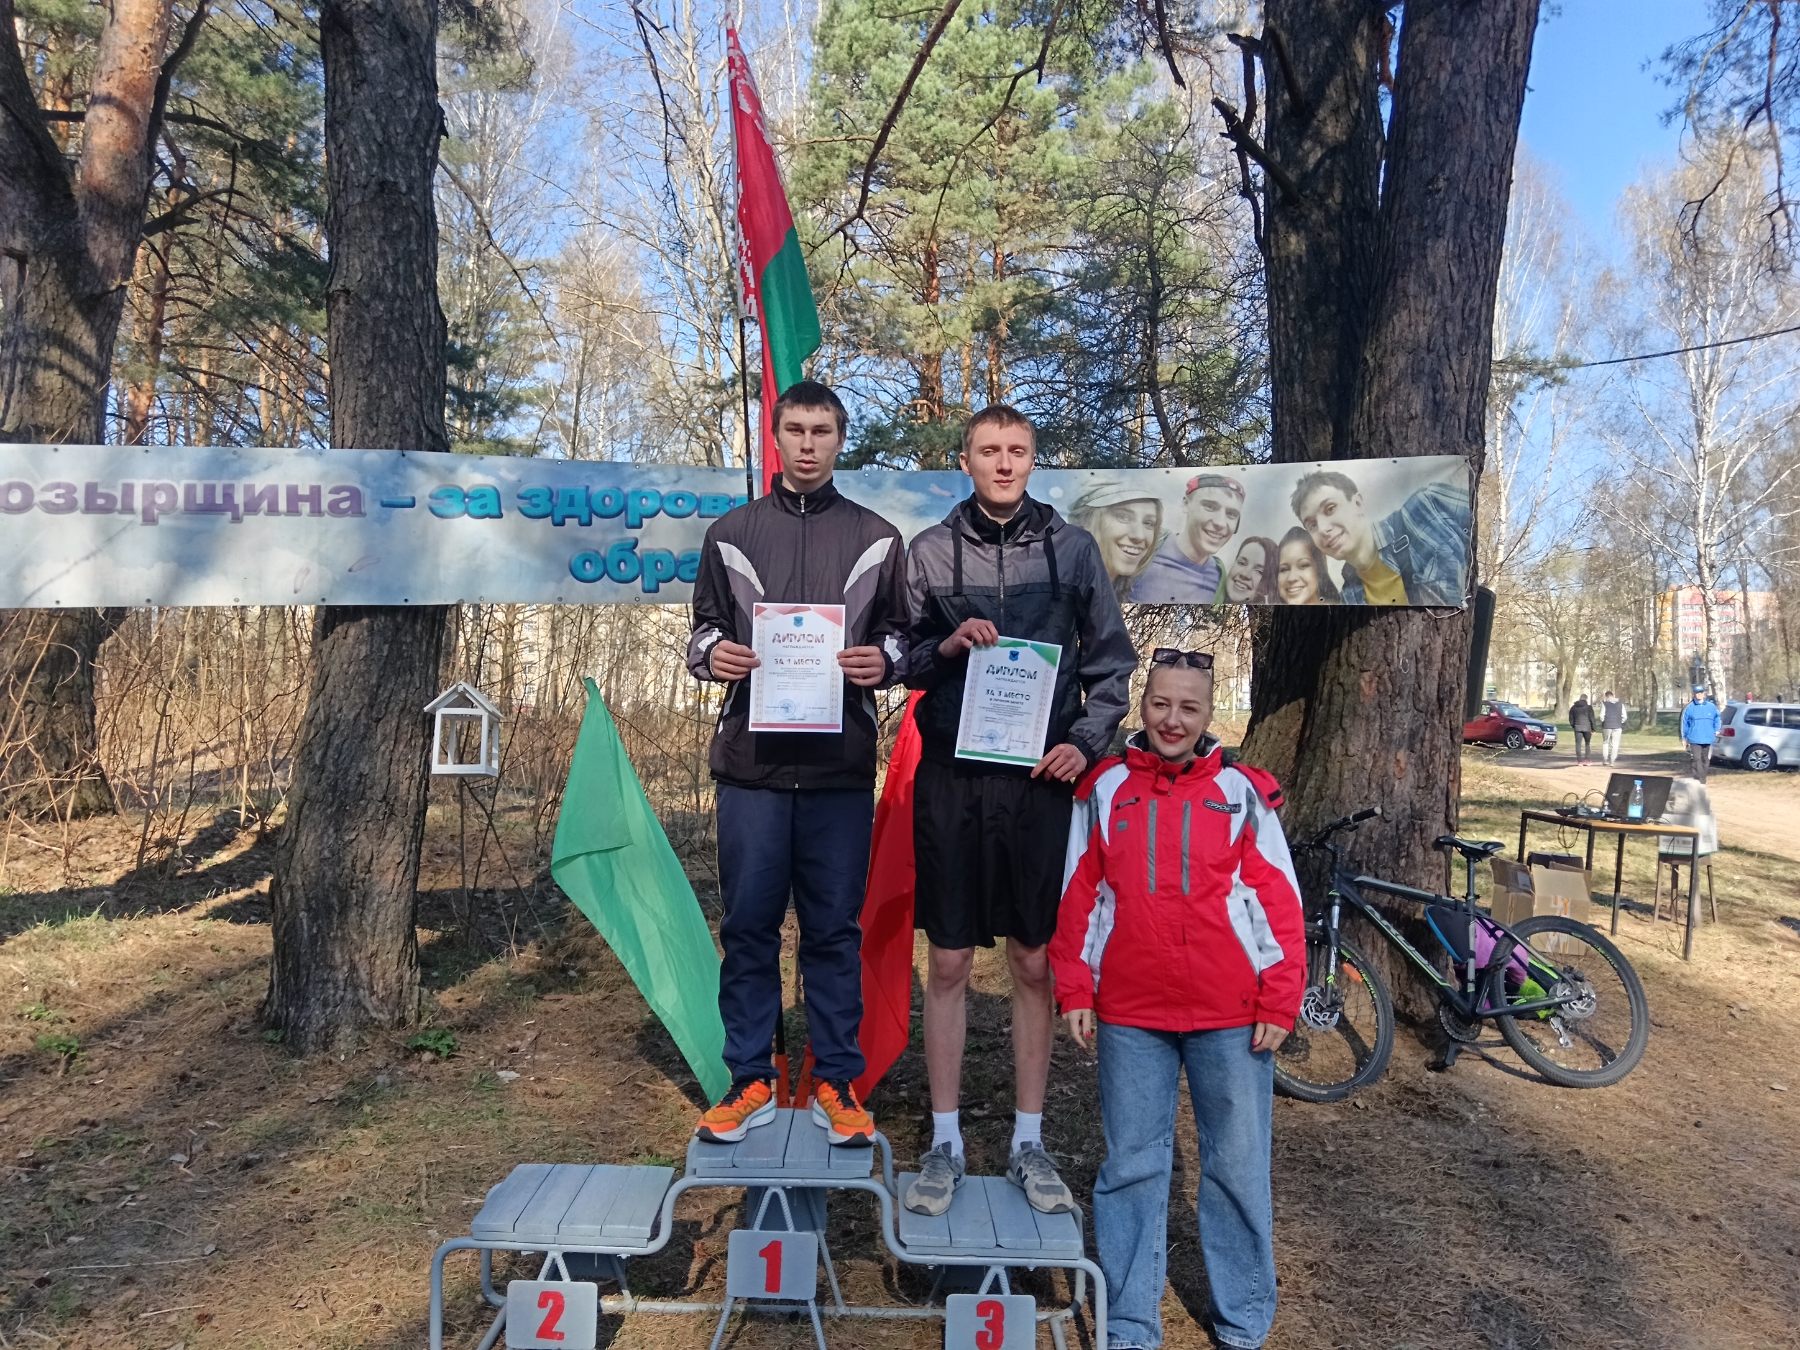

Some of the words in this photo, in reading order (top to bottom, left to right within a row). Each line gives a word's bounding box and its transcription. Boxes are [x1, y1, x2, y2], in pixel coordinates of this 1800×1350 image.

[428, 483, 505, 519] за
[517, 484, 748, 529] здоров
[772, 632, 825, 644] ДИПЛОМ
[793, 658, 821, 666] МЕСТО
[986, 664, 1038, 680] ДИПЛОМ
[1003, 691, 1031, 701] МЕСТО
[759, 1239, 782, 1293] 1
[536, 1290, 565, 1340] 2
[975, 1299, 1005, 1350] 3
